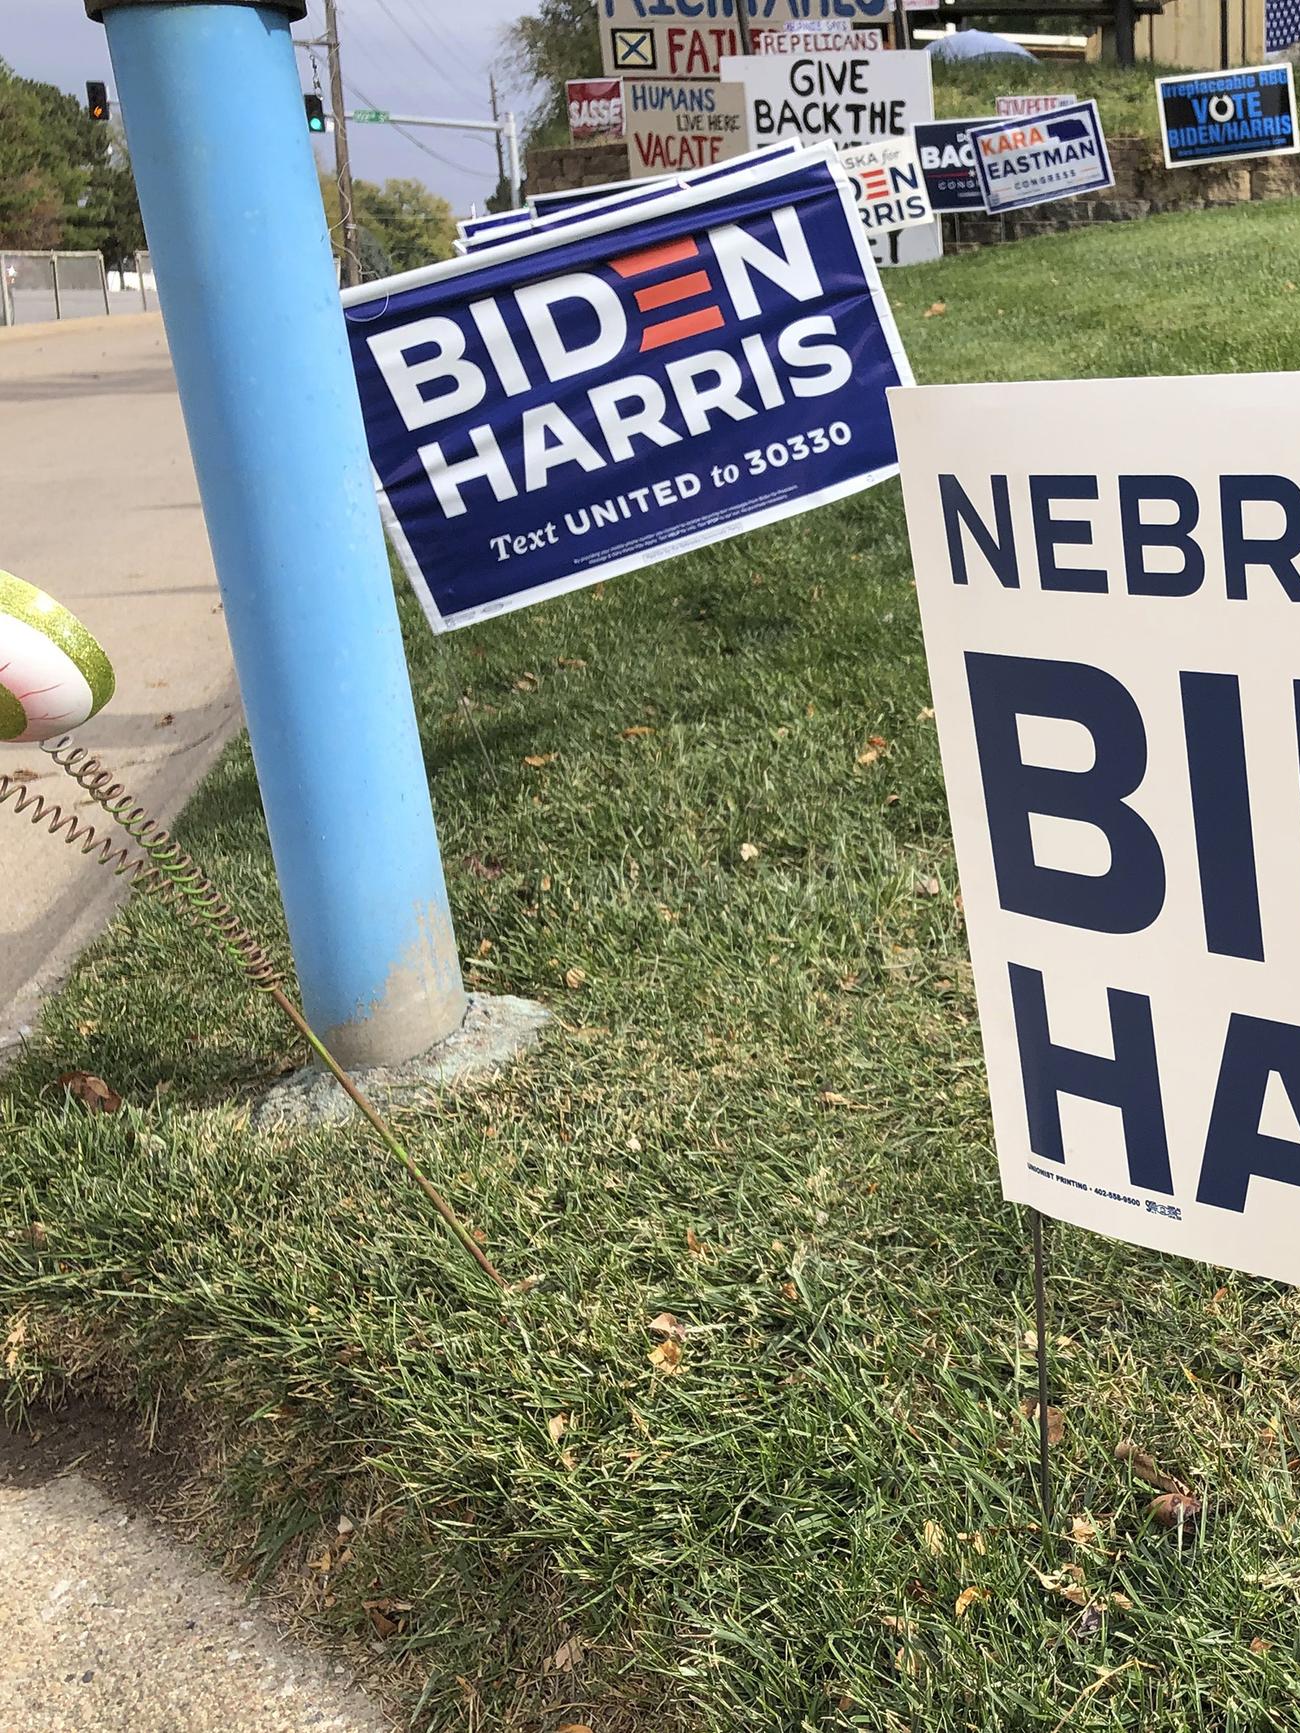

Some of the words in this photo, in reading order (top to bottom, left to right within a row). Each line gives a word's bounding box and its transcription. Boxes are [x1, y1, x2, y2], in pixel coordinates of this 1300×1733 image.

[790, 59, 870, 97] GIVE
[569, 97, 622, 127] SASSE
[632, 85, 716, 113] HUMANS
[1191, 91, 1263, 124] VOTE
[676, 115, 703, 132] LIVE
[708, 114, 741, 133] HERE
[754, 100, 842, 135] BACK
[845, 100, 907, 135] THE
[1168, 114, 1292, 149] BIDEN/HARRIS
[634, 133, 724, 169] VACATE
[920, 144, 976, 170] BAC
[981, 126, 1046, 157] KARA
[987, 140, 1096, 180] EASTMAN
[938, 180, 980, 191] CONG
[1014, 169, 1077, 191] CONGRESS
[859, 196, 927, 229] RRIS
[367, 207, 824, 431] BIDEN
[418, 316, 853, 518] HARRIS
[490, 522, 560, 561] Text
[564, 473, 701, 535] UNITED
[710, 463, 740, 488] to
[743, 421, 852, 475] 30330
[1055, 1174, 1088, 1191] PRINTING
